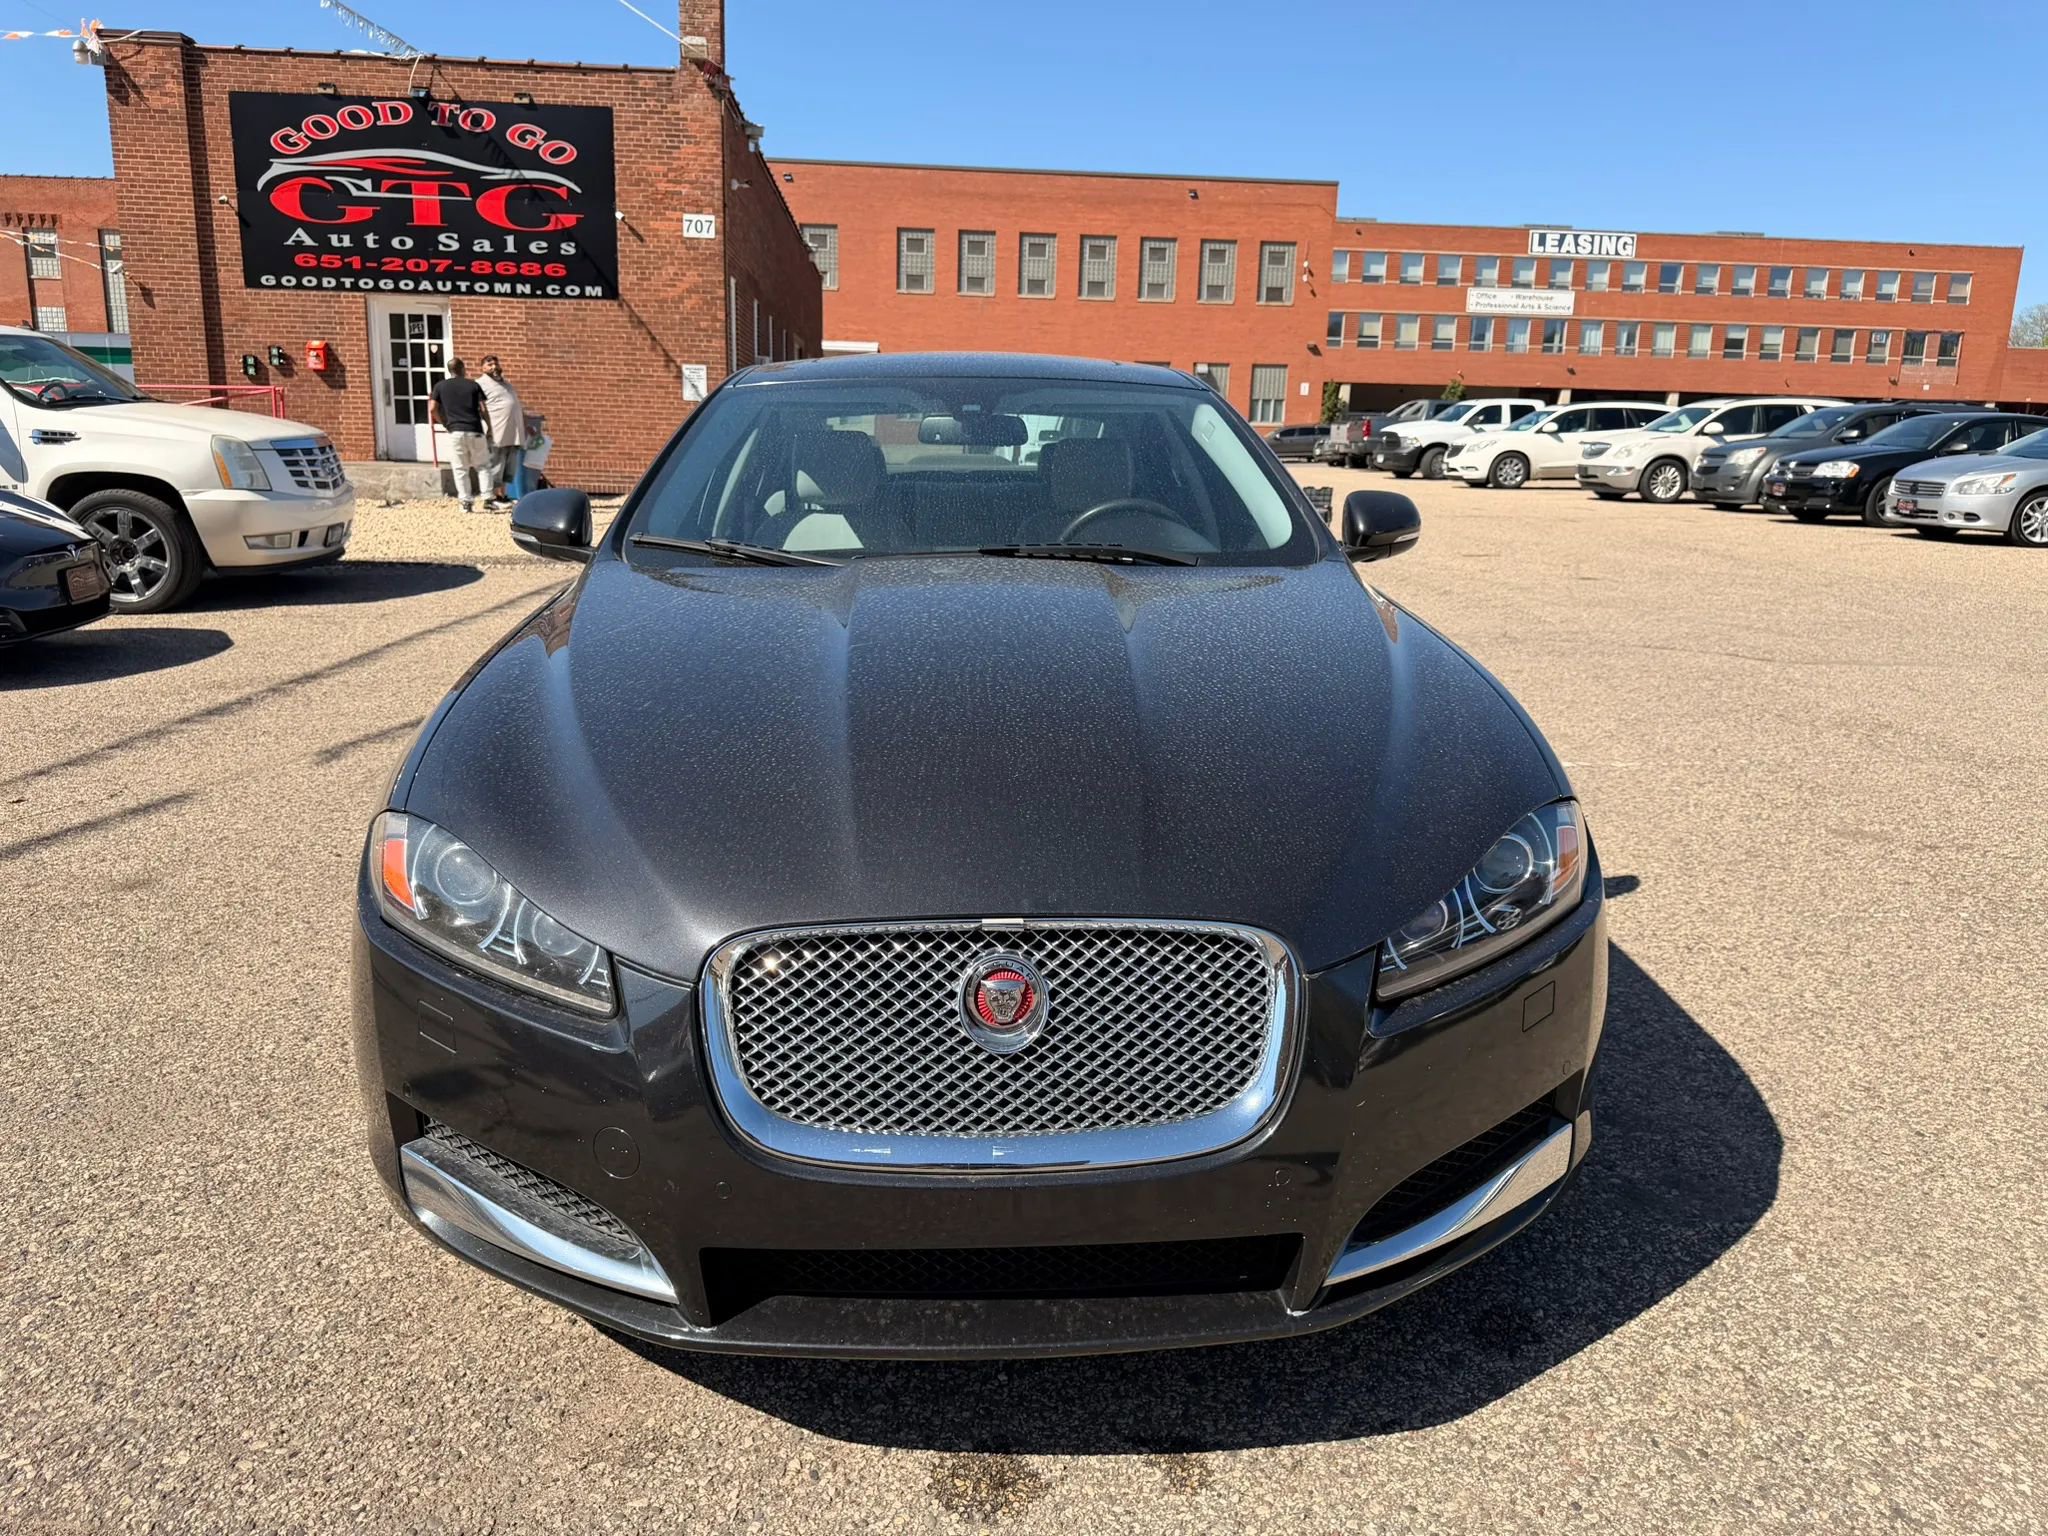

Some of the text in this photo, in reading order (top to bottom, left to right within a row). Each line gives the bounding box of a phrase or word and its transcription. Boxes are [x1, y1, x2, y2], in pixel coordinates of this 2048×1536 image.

[270, 101, 578, 164] GOOD TO GO
[269, 177, 584, 231] GTG
[684, 219, 714, 234] 707
[283, 228, 577, 256] Auto Sales
[1531, 232, 1633, 256] LEASING
[294, 253, 567, 277] 651-207-8686
[259, 274, 603, 297] GOODTOGOAUTOMN.COM
[1476, 292, 1497, 300] Office
[1475, 302, 1519, 310] Professional
[1520, 302, 1535, 310] Arts
[975, 961, 1034, 981] JAGUAR
